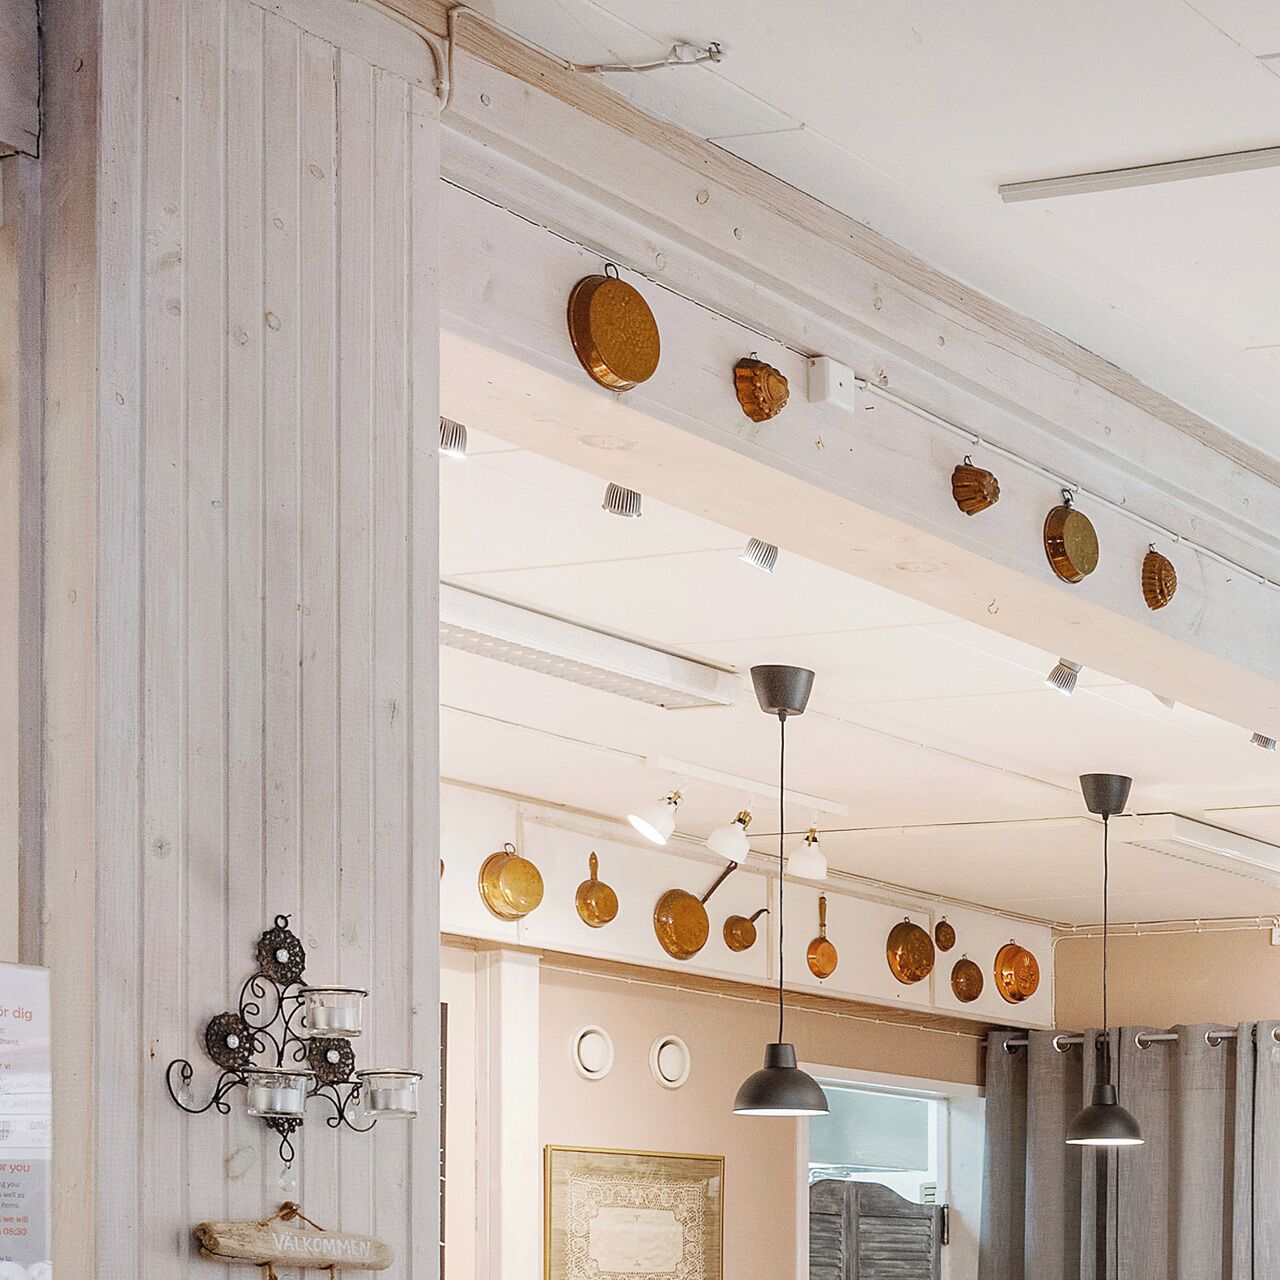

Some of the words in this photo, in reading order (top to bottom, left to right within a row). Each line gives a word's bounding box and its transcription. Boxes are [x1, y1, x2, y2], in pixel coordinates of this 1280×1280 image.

[13, 1006, 33, 1021] dig
[9, 1163, 31, 1174] you
[271, 1232, 372, 1257] VÄLKOMMEN
